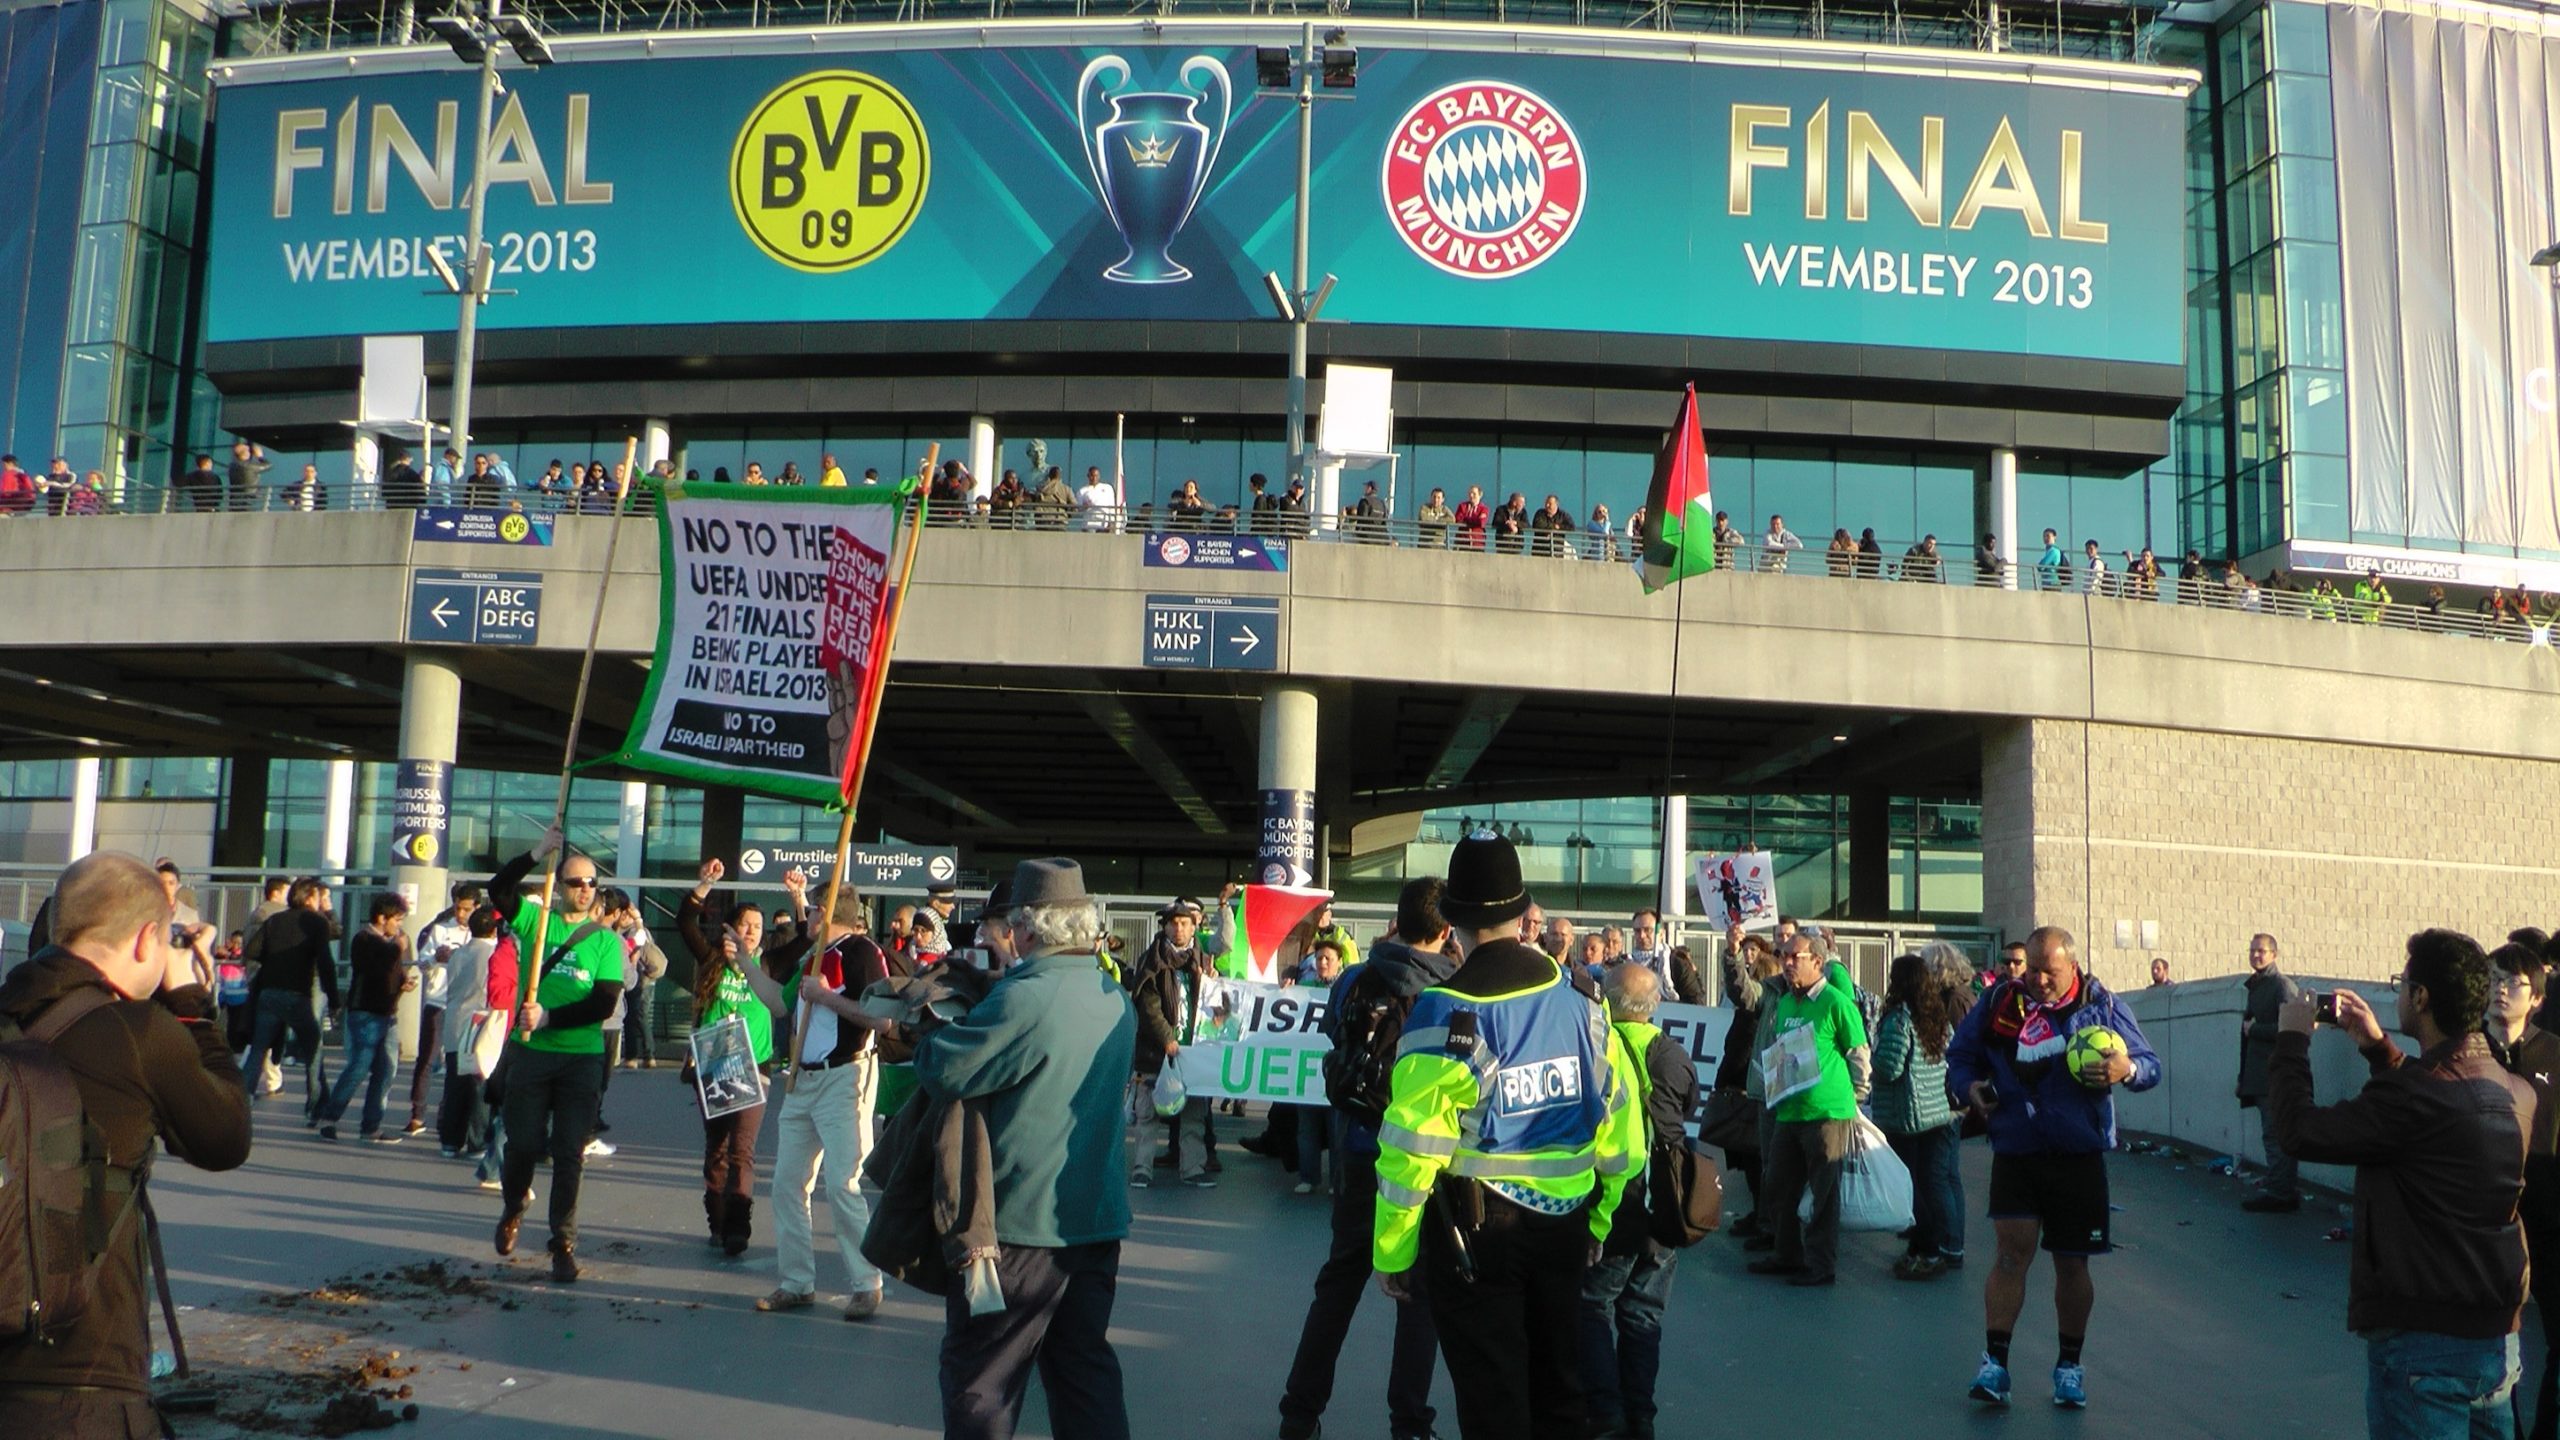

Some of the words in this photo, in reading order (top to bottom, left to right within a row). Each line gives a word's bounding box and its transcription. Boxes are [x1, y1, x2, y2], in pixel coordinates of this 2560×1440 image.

[1396, 118, 1436, 164] FC
[1436, 91, 1574, 170] BAYERN
[274, 93, 613, 219] FINAL
[761, 94, 906, 210] BVB
[1727, 97, 2110, 244] FINAL
[801, 209, 853, 249] 09
[1396, 195, 1571, 270] MÜNCHEN
[283, 234, 469, 283] WEMBLE
[501, 229, 598, 273] 2013
[1743, 242, 1977, 298] WEMBLEY
[1993, 259, 2094, 310] 2013
[459, 522, 496, 530] DORTMUND
[463, 514, 494, 523] BORUSSIA
[505, 516, 525, 534] BVB
[531, 513, 553, 521] FINAL
[457, 530, 497, 539] SUPPORTERS
[683, 517, 731, 554] NO
[735, 520, 777, 557] TO
[781, 523, 834, 561] THE
[1197, 540, 1206, 548] FC
[1207, 540, 1232, 549] BAYERN
[1264, 538, 1287, 547] FINAL
[832, 538, 885, 582] SHOW
[1193, 555, 1234, 564] SUPPORTERS
[2345, 555, 2380, 571] UEFA
[2382, 559, 2457, 580] CHAMPIONS
[461, 572, 498, 581] ENTRANCES
[690, 562, 749, 598] UEFA
[757, 569, 828, 603] UNDER
[830, 564, 879, 604] ISRAEL
[483, 588, 526, 606] ABC
[834, 584, 872, 620] THE
[1195, 597, 1232, 606] ENTRANCES
[482, 609, 535, 628] DEFG
[706, 600, 729, 632] 21
[733, 605, 816, 640] FINALS
[830, 604, 871, 644] RED
[1154, 611, 1204, 630] HJKL
[692, 635, 741, 664] BEING
[826, 625, 869, 669] CARD
[1153, 632, 1201, 650] MNP
[683, 664, 711, 690] IN
[714, 667, 774, 698] ISRAEL
[774, 672, 827, 701] 2013
[723, 711, 742, 731] NO
[748, 714, 776, 734] TO
[668, 727, 722, 751] ISRAELI
[723, 737, 805, 759] APARTHEID
[1263, 818, 1276, 830] FC
[772, 848, 839, 864] Turnstiles
[856, 851, 923, 867] Turnstiles
[1259, 845, 1314, 860] SUPPORTER
[795, 864, 820, 878] A-G
[877, 868, 902, 882] H-P
[1248, 996, 1328, 1034] ISR
[1221, 1045, 1328, 1097] UEF
[1504, 1060, 1577, 1108] POLICE
